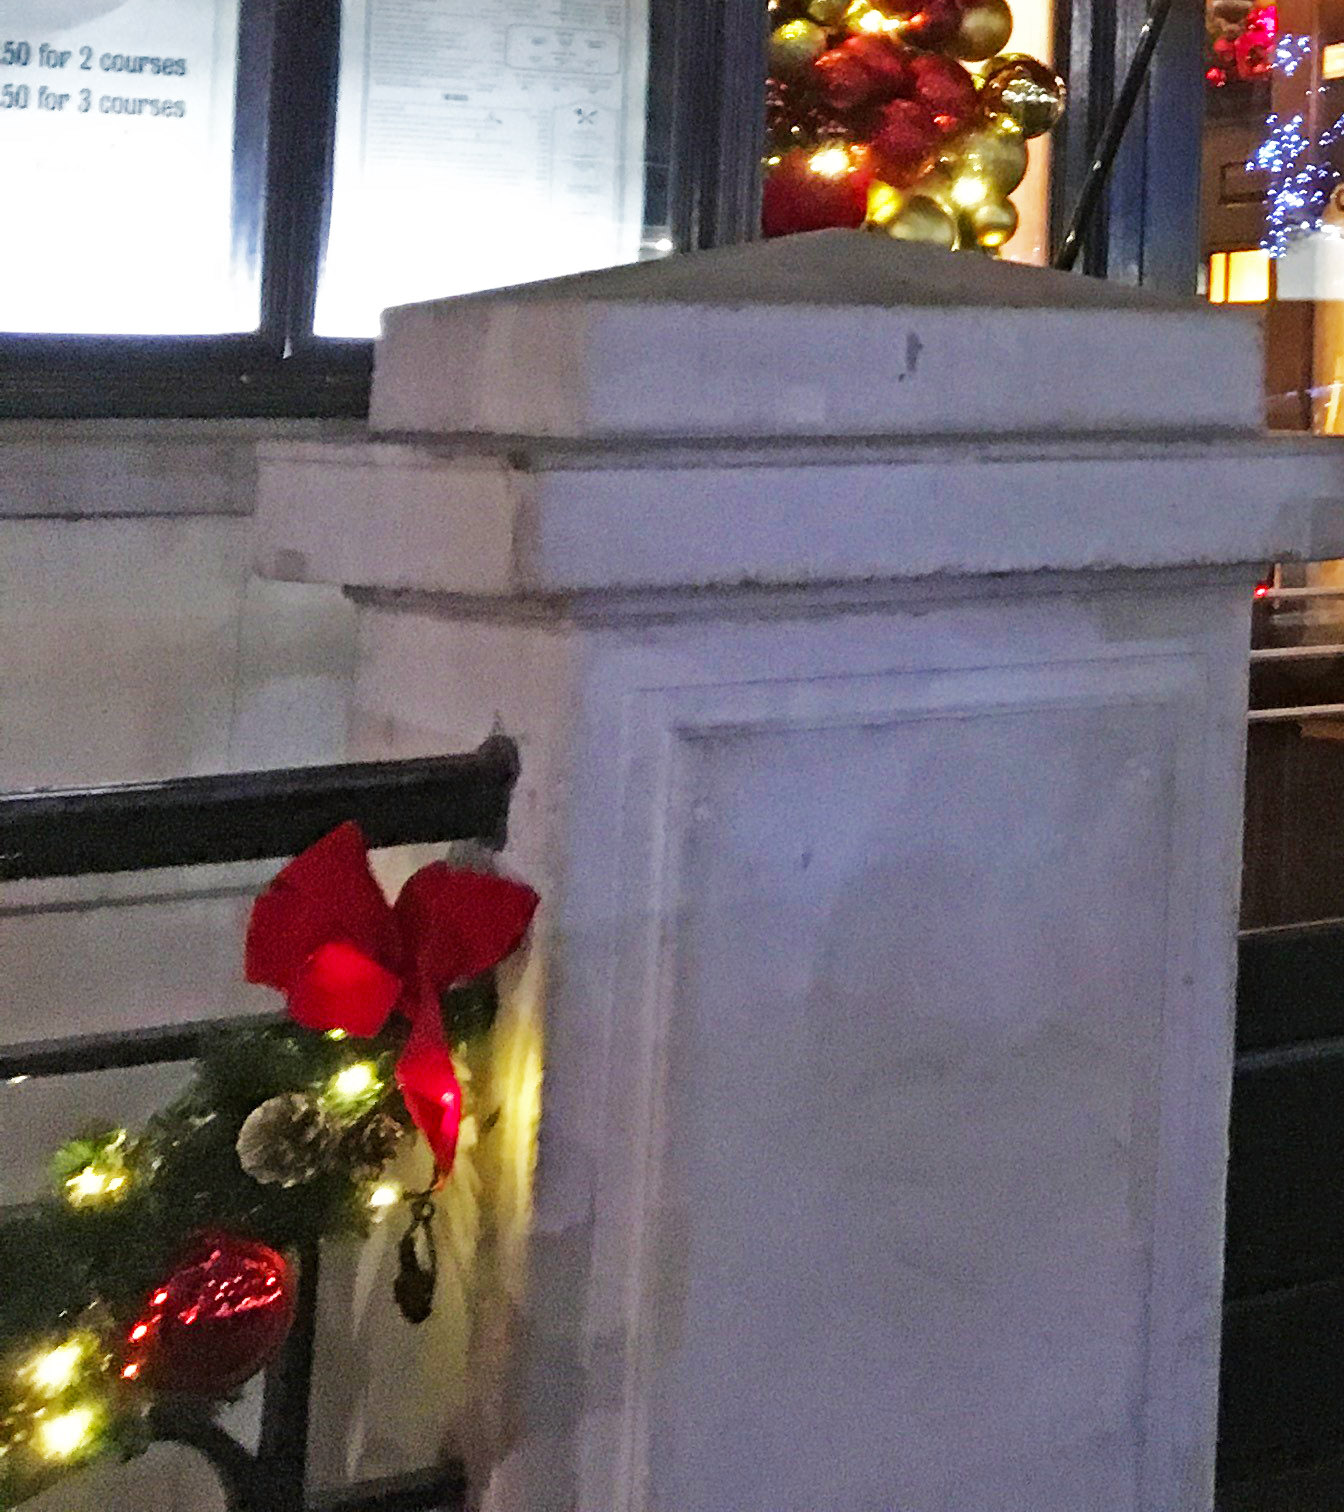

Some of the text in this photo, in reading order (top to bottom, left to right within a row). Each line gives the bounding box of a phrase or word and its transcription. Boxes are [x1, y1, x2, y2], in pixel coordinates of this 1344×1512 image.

[39, 42, 72, 69] for
[79, 45, 93, 70] 2
[100, 52, 187, 76] courses
[38, 85, 70, 111] for
[78, 88, 92, 113] 3
[99, 94, 187, 118] courses
